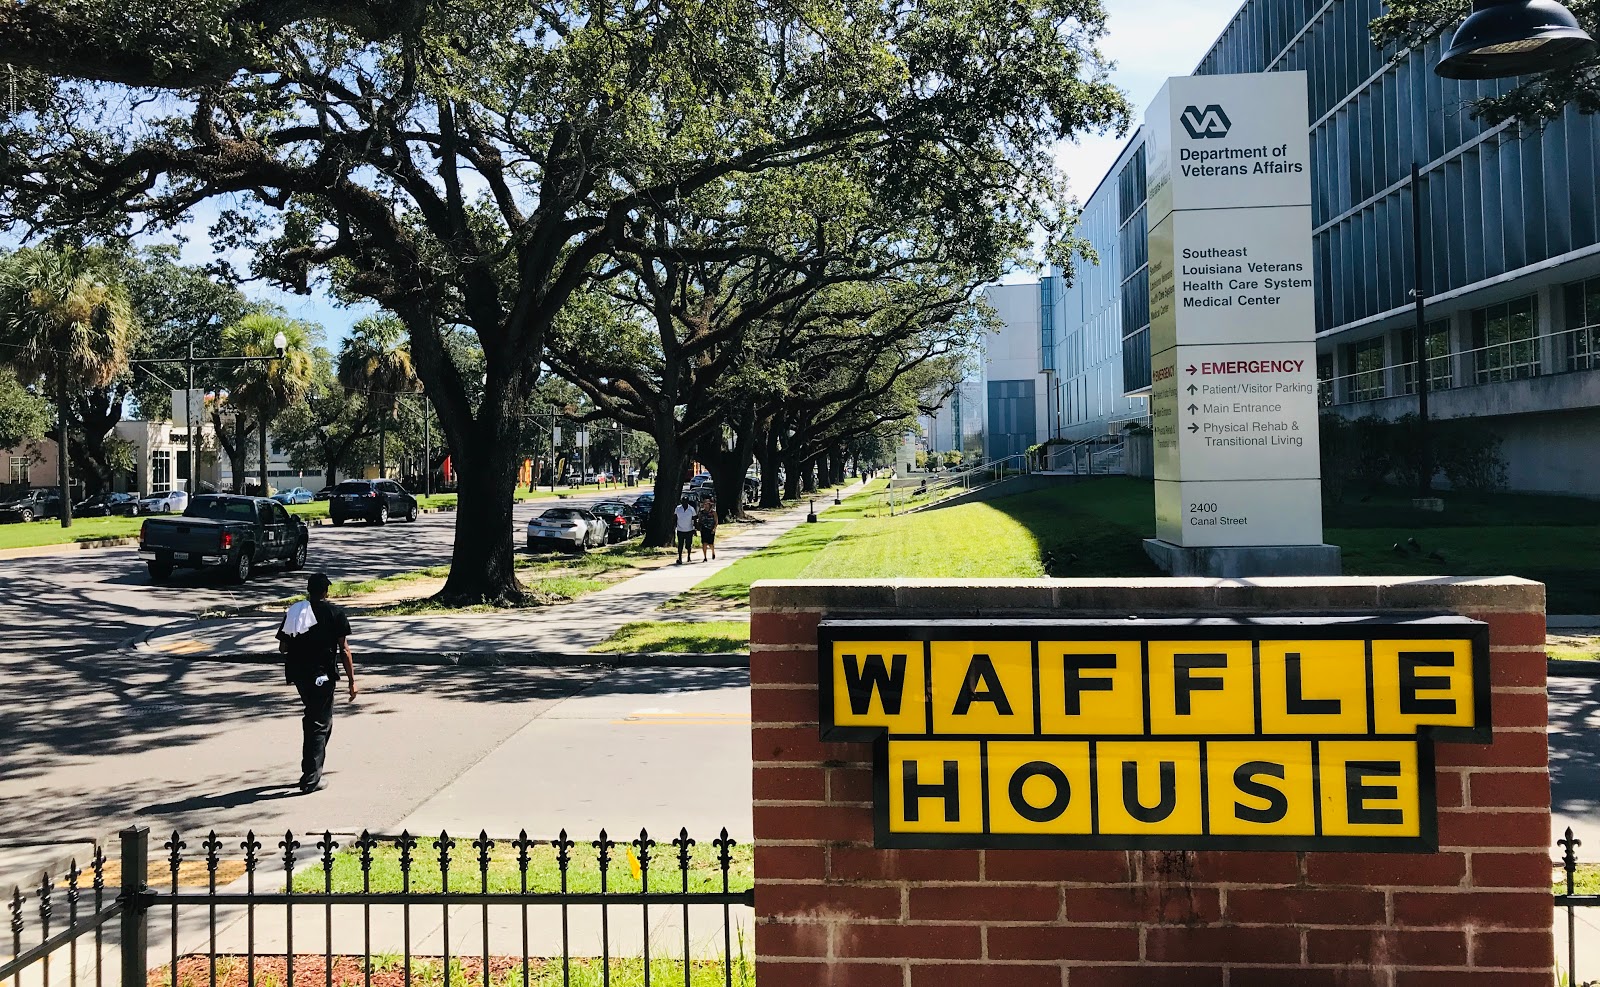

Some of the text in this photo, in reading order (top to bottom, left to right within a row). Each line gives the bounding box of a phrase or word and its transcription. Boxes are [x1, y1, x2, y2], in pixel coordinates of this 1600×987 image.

[1180, 144, 1287, 163] Department of
[1181, 162, 1248, 177] Veterans
[1253, 160, 1303, 175] Affairs
[1182, 246, 1248, 259] Southeast
[1182, 261, 1303, 275] Louisiana Veterans
[1183, 279, 1223, 291] Health
[1228, 279, 1259, 290] Care
[1264, 277, 1313, 290] System
[1183, 295, 1232, 307] Medical
[1237, 294, 1281, 306] Center
[1201, 359, 1305, 375] EMERGENCY
[1202, 382, 1313, 395] Patient/Visitor Parking
[1203, 403, 1282, 413] Main Entrance
[1203, 421, 1300, 435] Physical Rehab &
[1204, 435, 1303, 447] Transitional Living
[1190, 503, 1218, 513] 2400
[1190, 516, 1248, 526] Canal Street
[841, 651, 1457, 717] WAFFLE
[902, 760, 1404, 826] HOUSE
